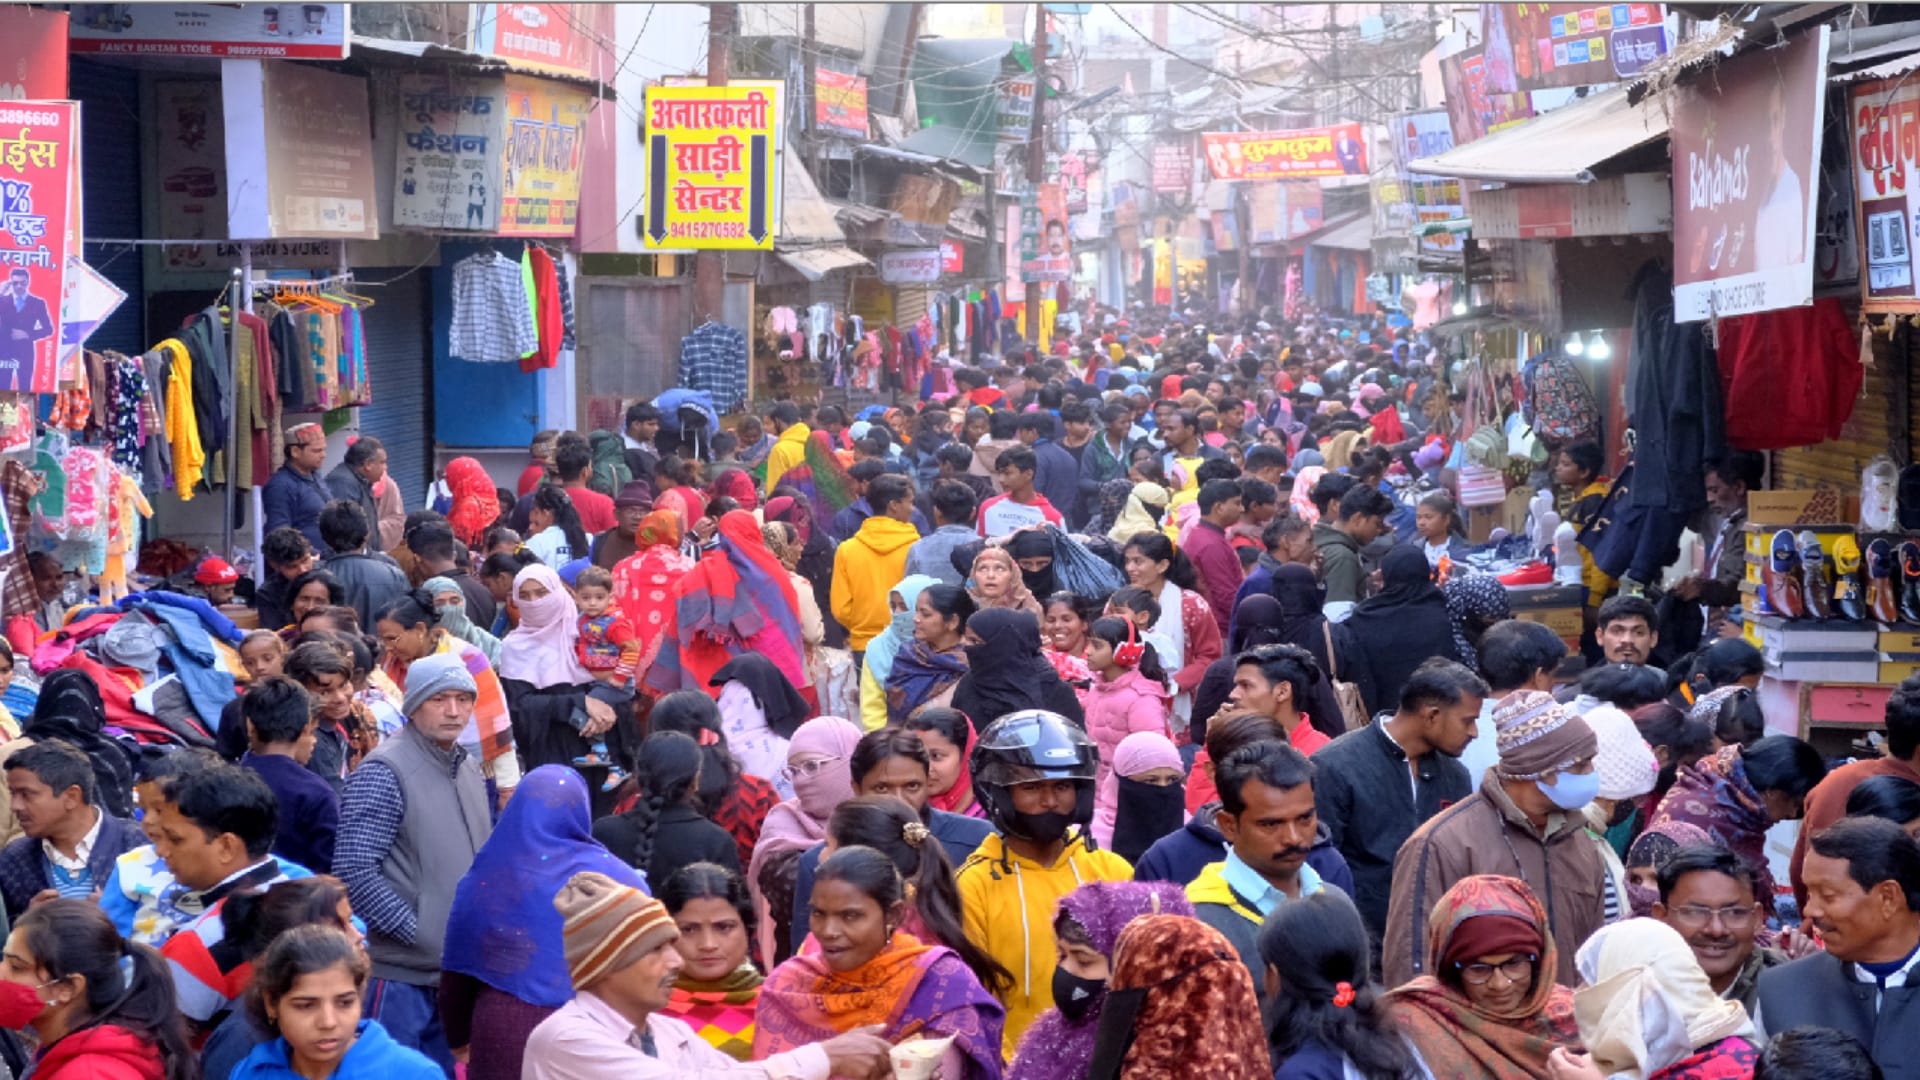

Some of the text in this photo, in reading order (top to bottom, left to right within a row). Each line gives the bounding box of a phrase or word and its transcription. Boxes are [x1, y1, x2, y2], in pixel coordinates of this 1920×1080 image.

[100, 43, 134, 53] FANCY
[180, 44, 213, 54] STORE
[651, 91, 769, 129] अनारकली
[673, 135, 745, 181] साड़ी
[1241, 136, 1333, 162] कुमकुम
[1690, 138, 1750, 211] Bahamas
[672, 179, 745, 212] सेन्टर
[8, 215, 46, 245] छूट
[671, 222, 745, 238] 9415270582
